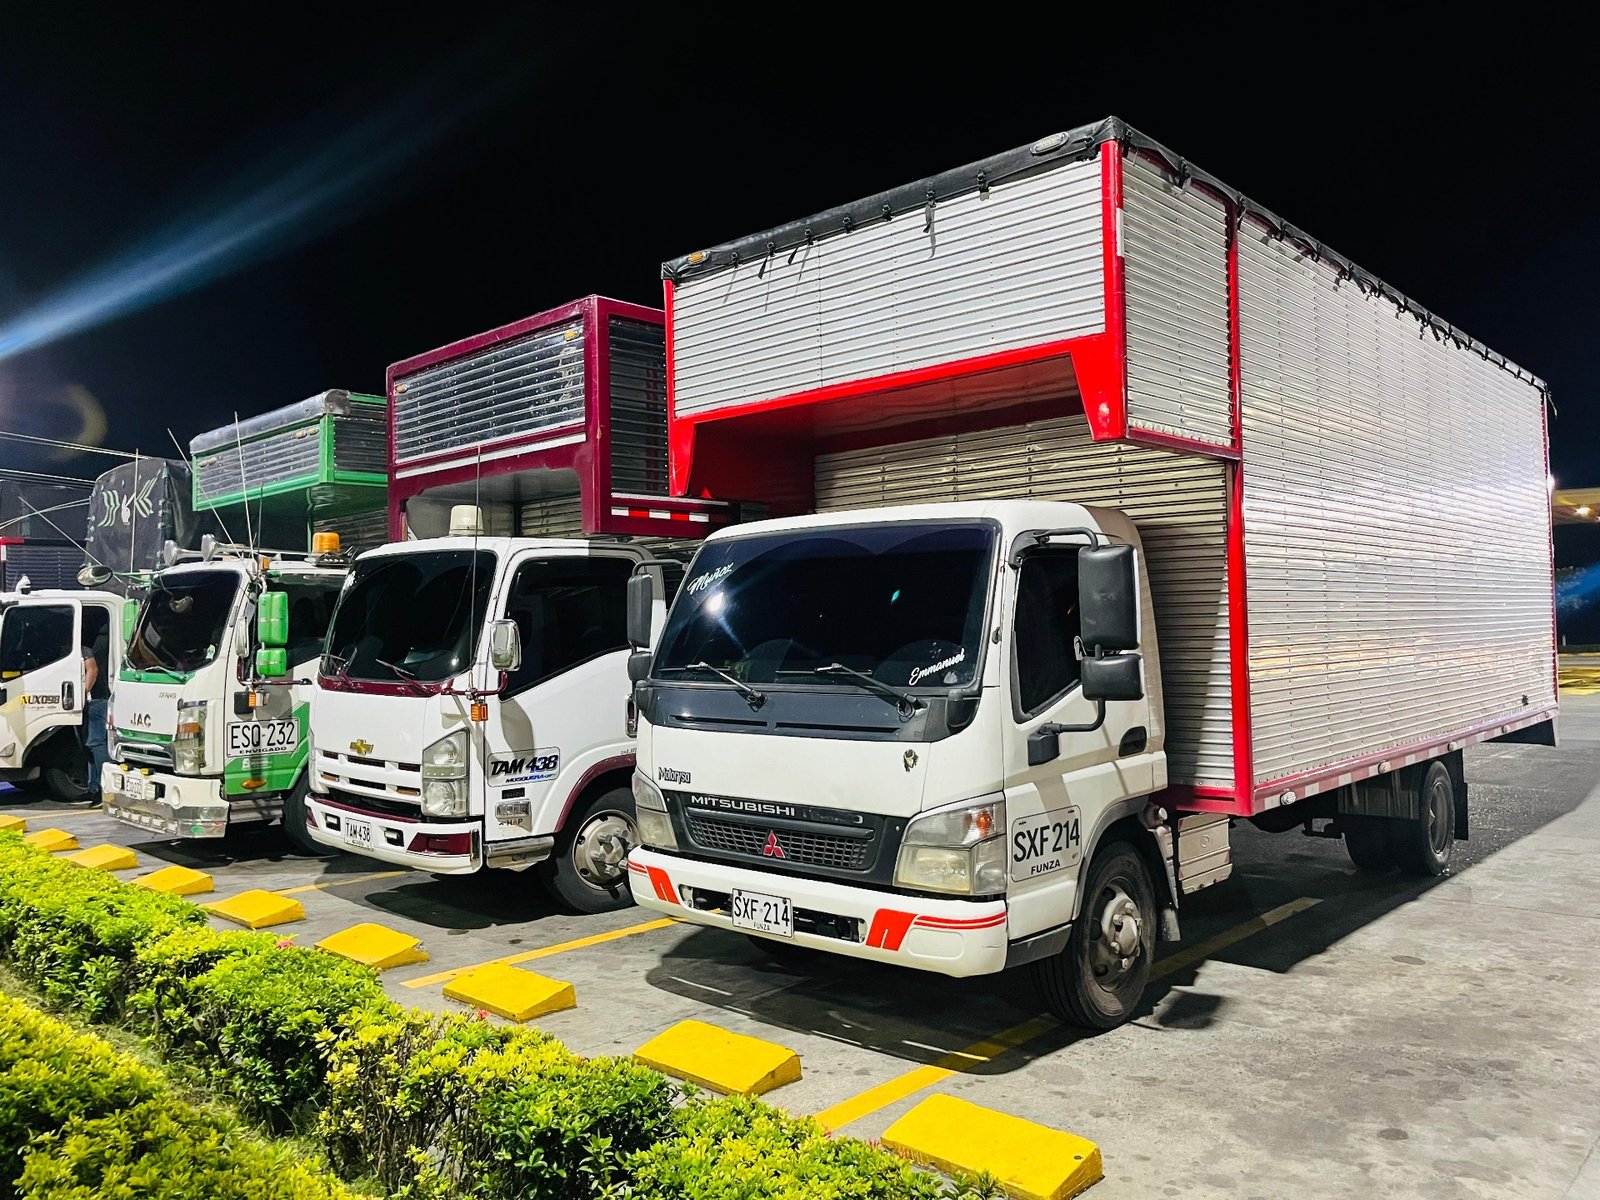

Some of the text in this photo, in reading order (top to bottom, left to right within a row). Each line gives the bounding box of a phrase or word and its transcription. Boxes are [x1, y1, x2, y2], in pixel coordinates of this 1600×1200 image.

[909, 647, 965, 686] Emmanuel
[130, 713, 152, 728] JAC
[239, 746, 287, 754] ENVIGADO
[490, 754, 559, 776] TAM 438
[691, 795, 795, 817] MITSUBISHI
[1030, 858, 1061, 875] FUNZA
